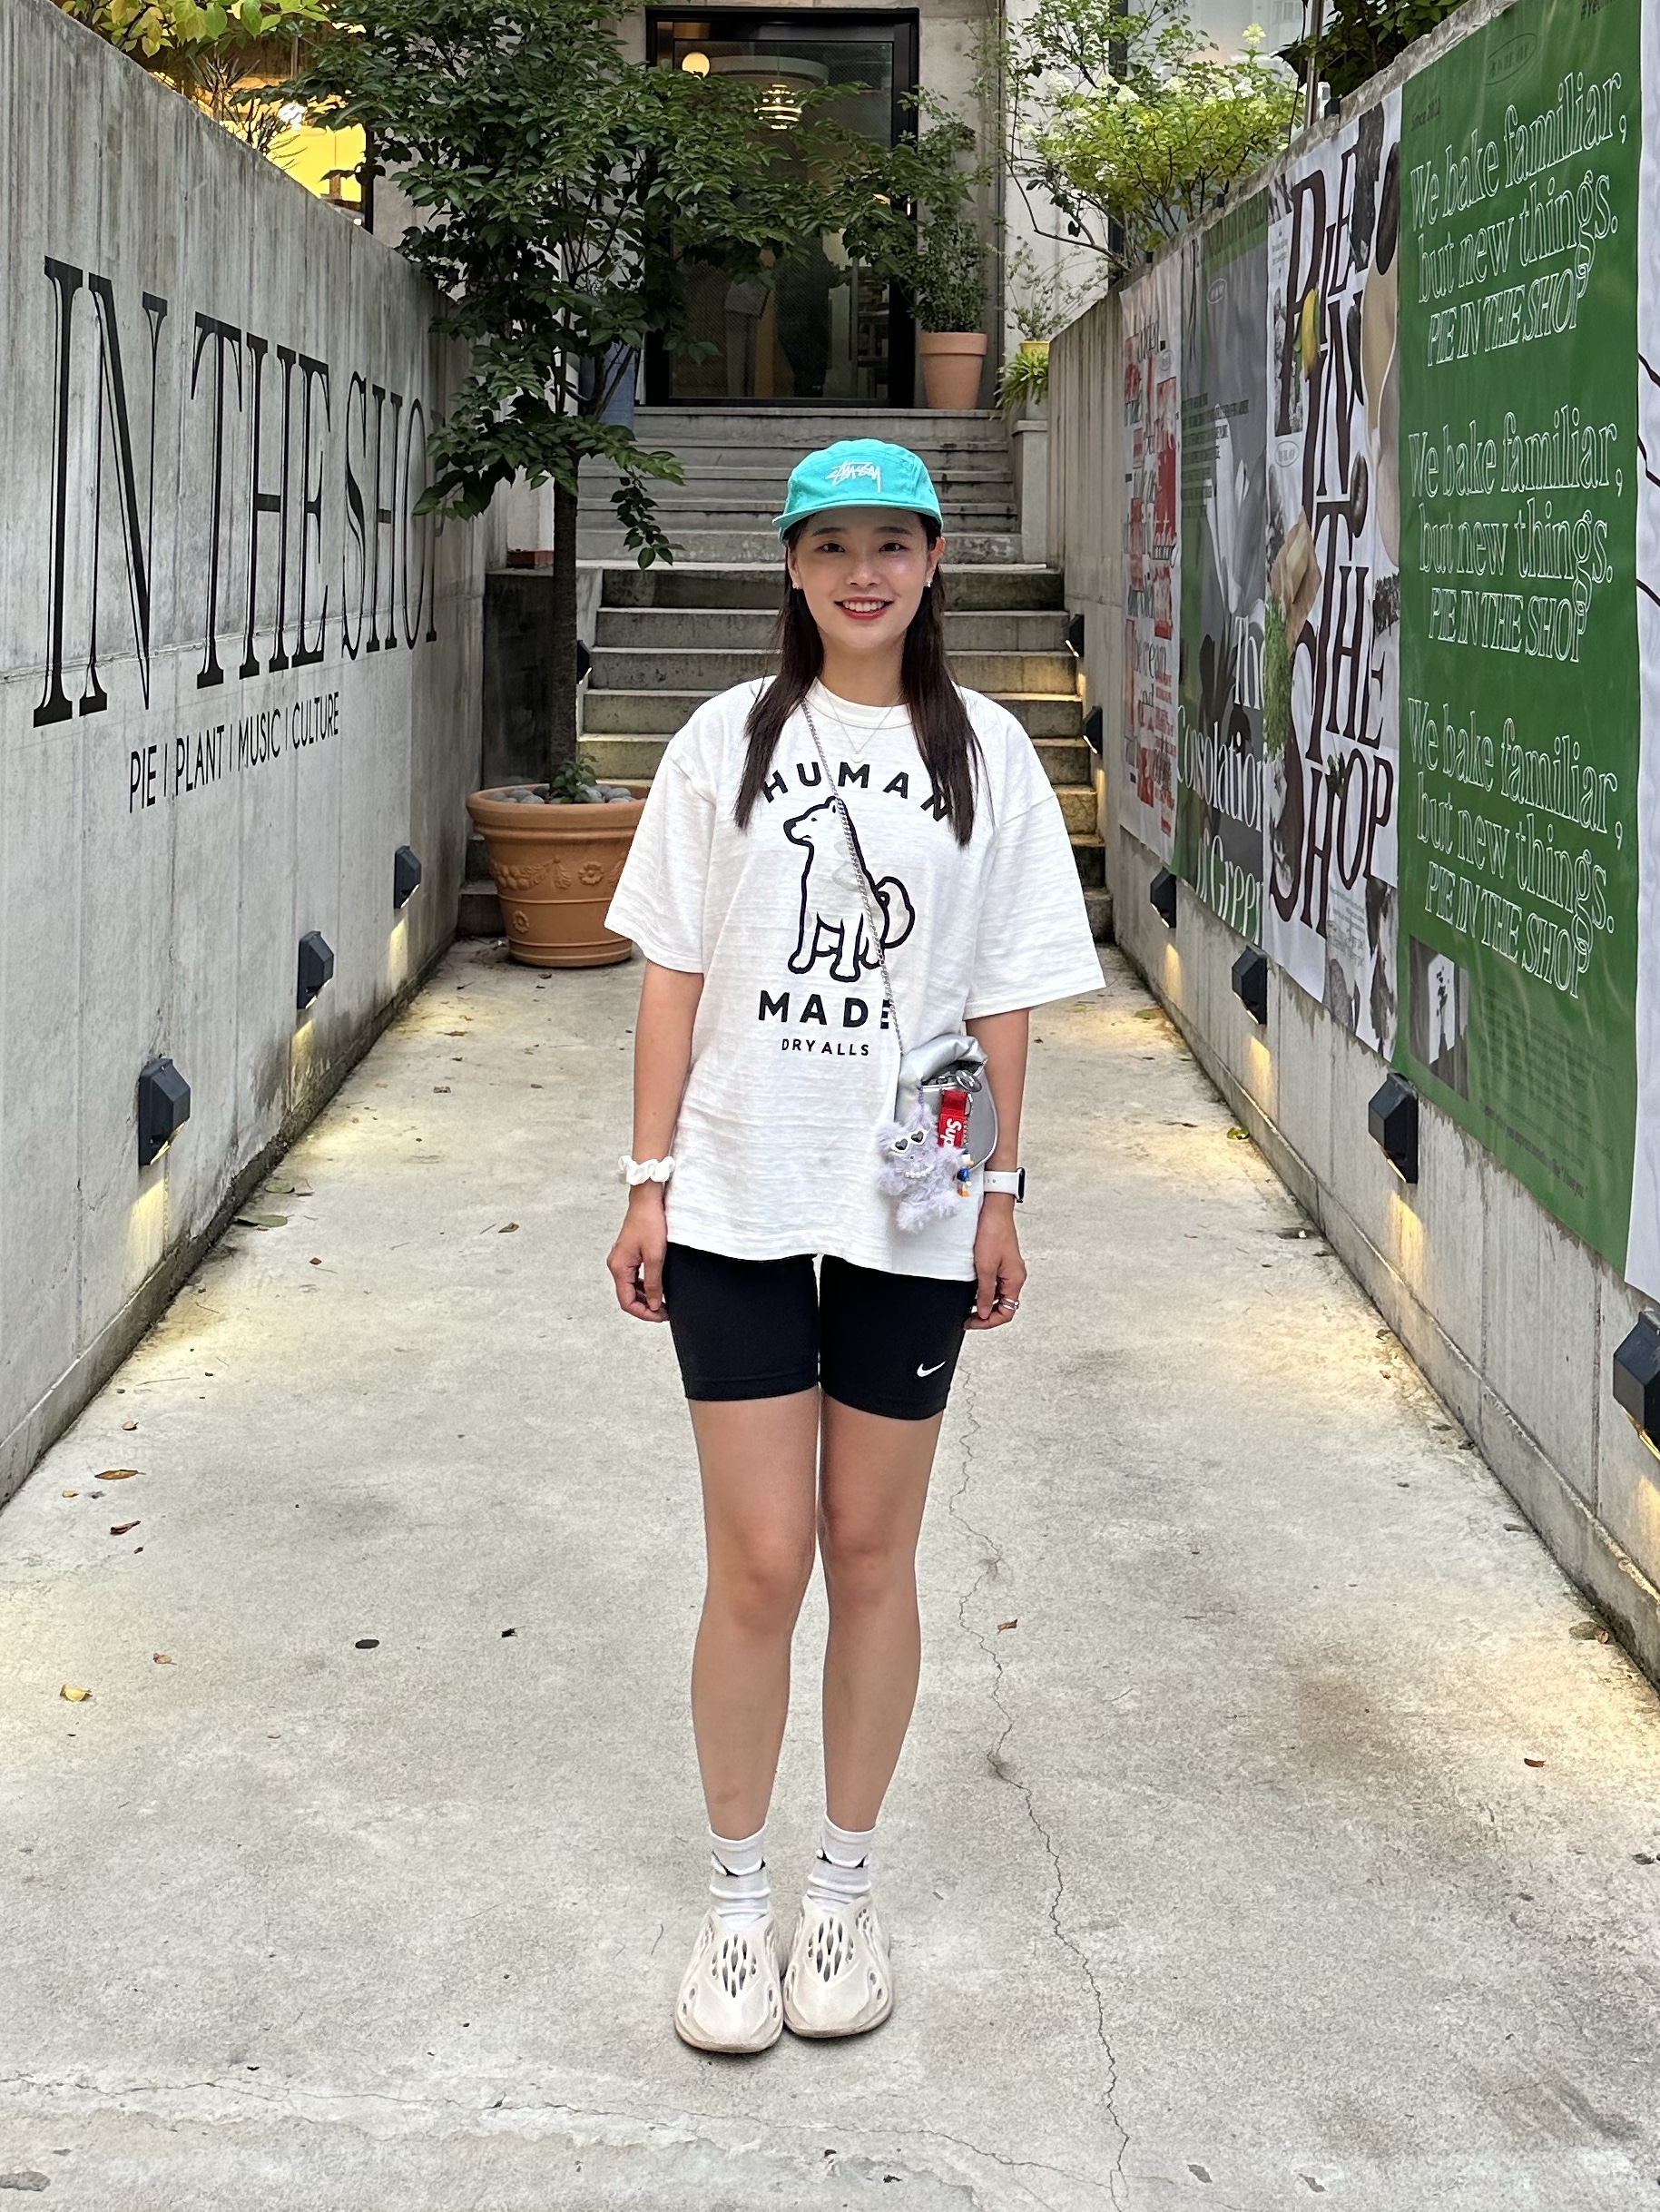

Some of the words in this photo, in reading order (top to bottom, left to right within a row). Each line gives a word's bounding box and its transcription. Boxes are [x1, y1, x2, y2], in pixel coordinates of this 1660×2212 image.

[1410, 161, 1439, 231] We
[1442, 128, 1499, 218] bake
[1504, 72, 1627, 188] familiar,
[1418, 231, 1455, 303] but
[1459, 216, 1515, 289] new
[1519, 170, 1619, 280] things.
[1428, 306, 1457, 367] PIE
[1457, 299, 1482, 359] IN
[1483, 284, 1526, 352] THE
[1522, 262, 1589, 342] SHOP
[34, 256, 167, 727] IN
[191, 311, 331, 690] THE
[1408, 431, 1439, 497] We
[1442, 419, 1497, 496] bake
[1501, 404, 1623, 497] familiar,
[1419, 502, 1453, 574] but
[1457, 521, 1508, 576] new
[1514, 497, 1613, 616] things.
[1428, 587, 1457, 642] PIE
[1458, 590, 1480, 645] IN
[1481, 593, 1524, 653] THE
[1525, 595, 1588, 663] SHOP
[130, 744, 157, 814] PIE
[176, 724, 224, 797] PLANT
[238, 708, 280, 772] MUSIC
[291, 691, 339, 750] CULTURE
[1408, 697, 1439, 772] We
[1442, 703, 1494, 791] bake
[1501, 717, 1623, 850] familiar,
[1417, 772, 1453, 854] but
[1458, 810, 1509, 880] new
[1516, 813, 1615, 956] things.
[1425, 860, 1456, 925] PIE
[1456, 877, 1481, 939] IN
[1481, 889, 1523, 964] THE
[1522, 912, 1590, 999] SHOP
